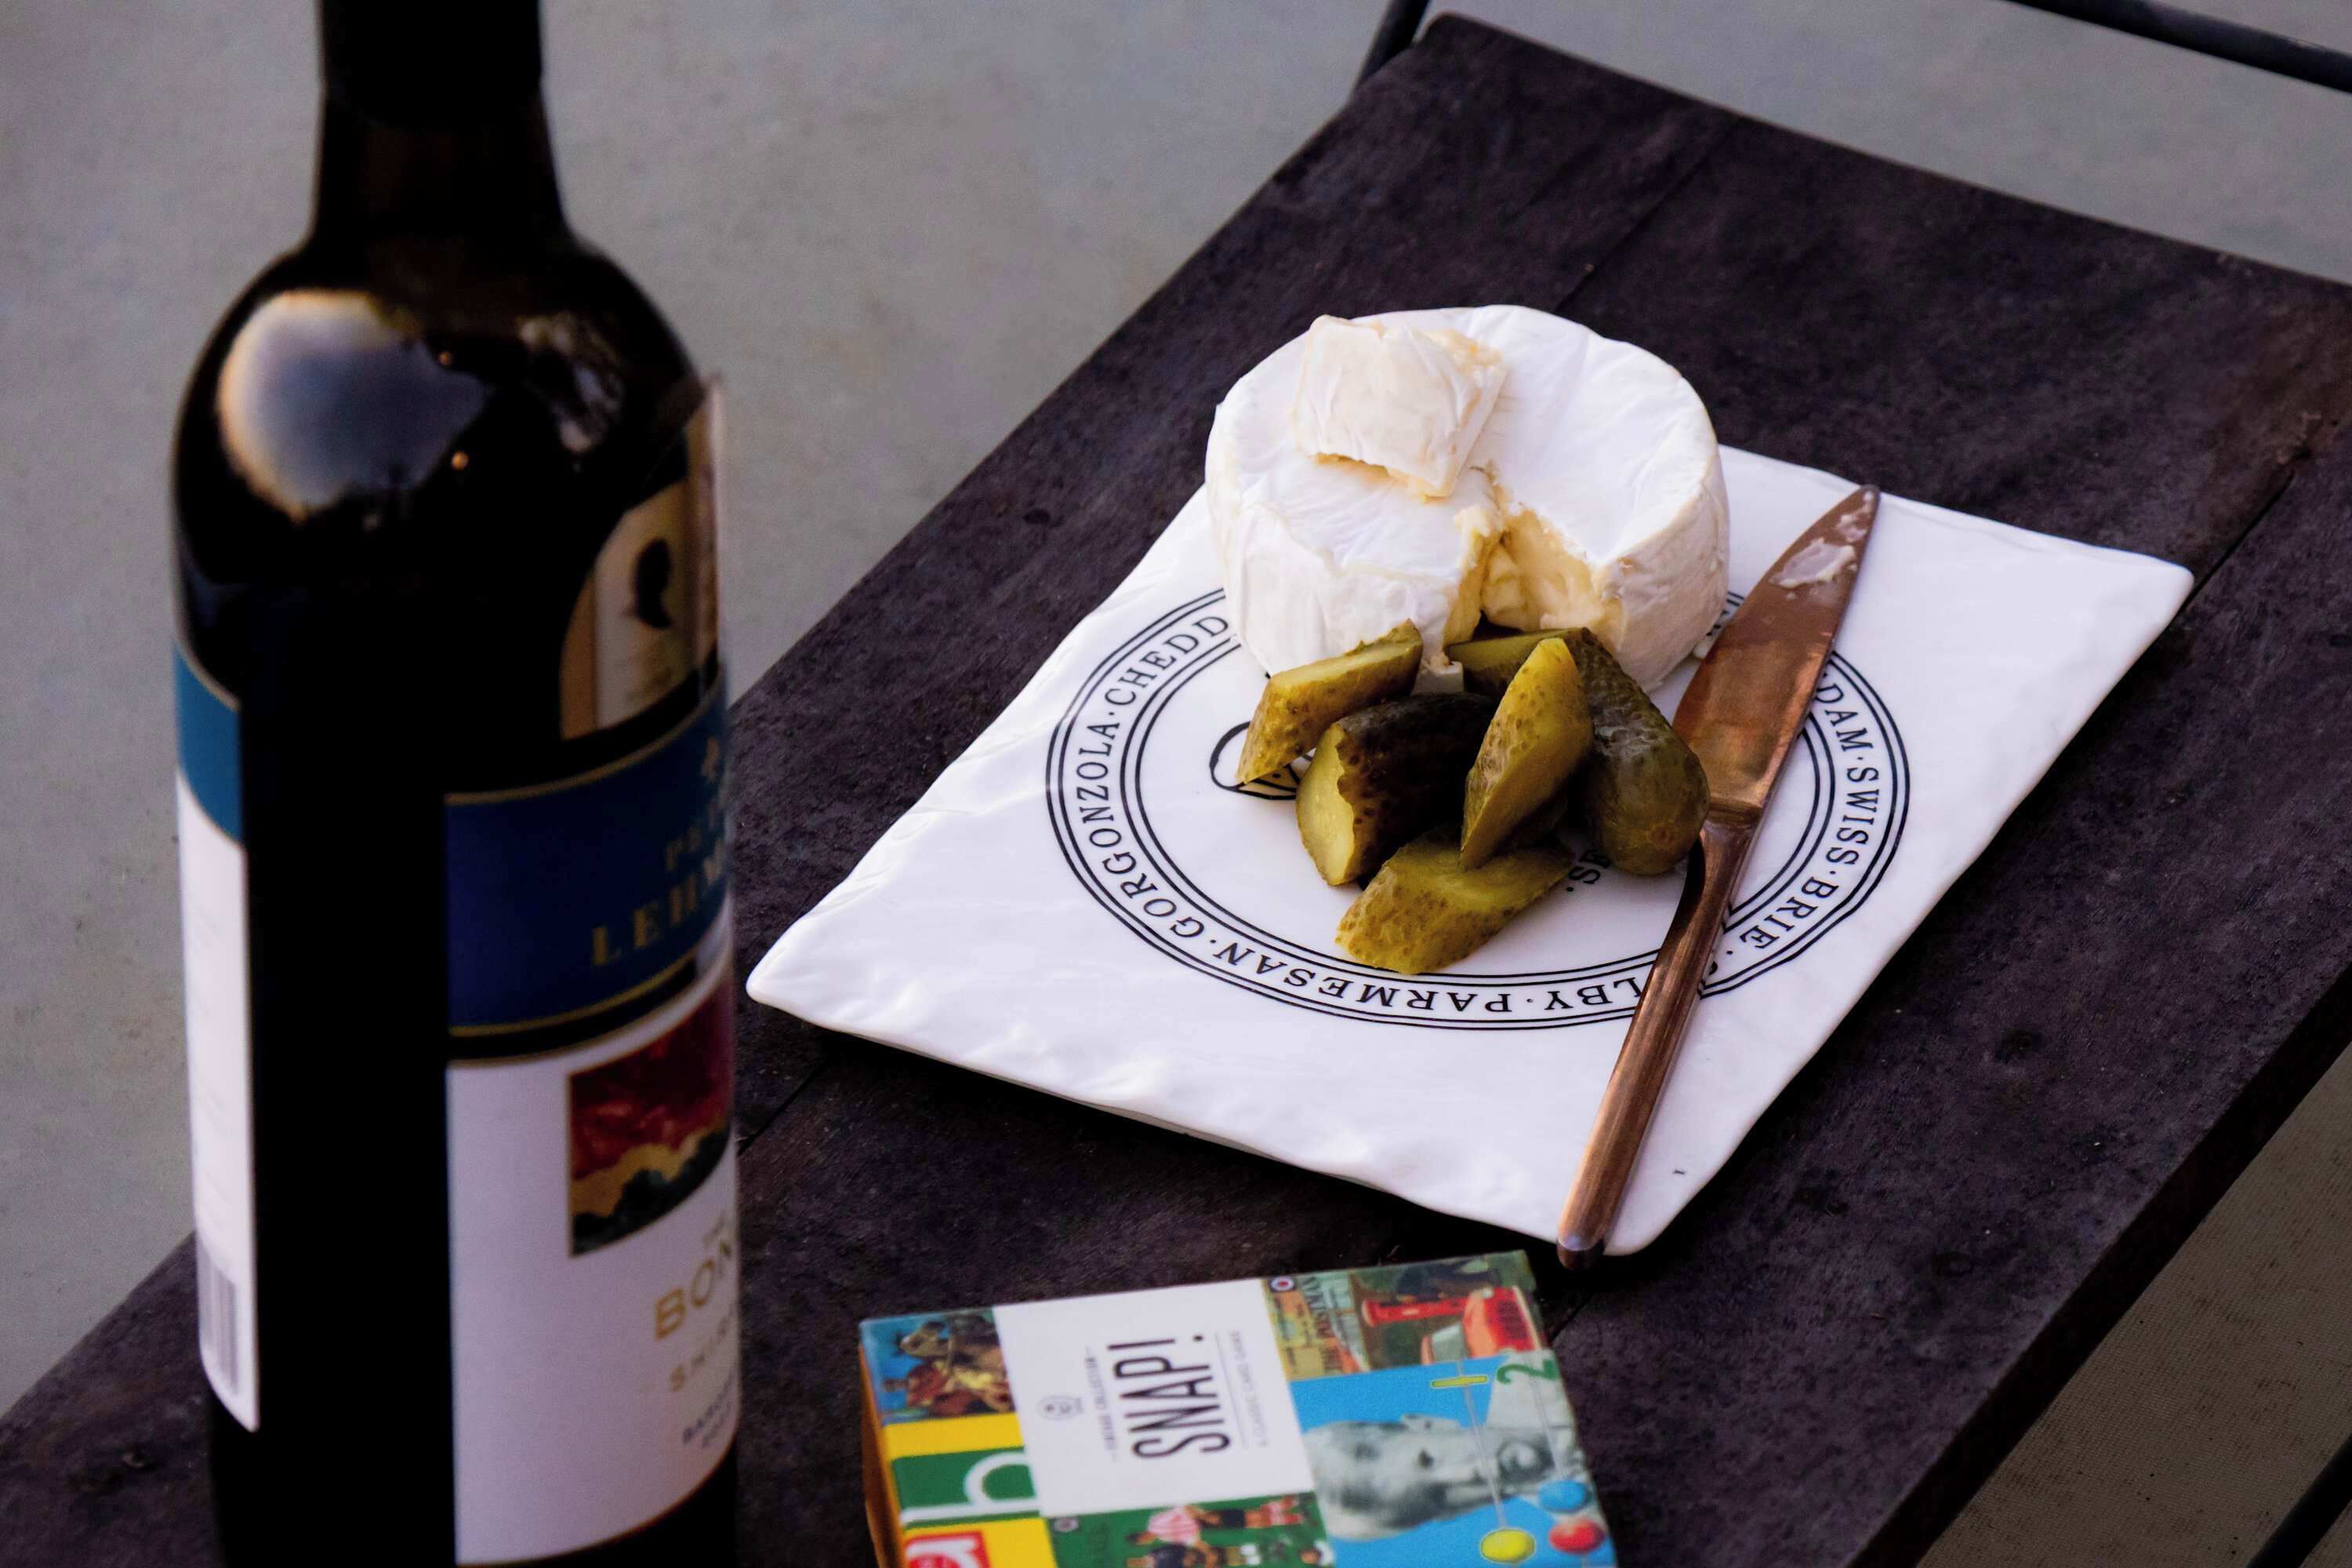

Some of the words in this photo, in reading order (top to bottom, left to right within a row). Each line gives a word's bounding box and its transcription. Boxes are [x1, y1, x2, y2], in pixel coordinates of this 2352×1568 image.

[1105, 616, 1229, 706] CHEDD
[1814, 681, 1875, 752] DAM
[1076, 722, 1205, 938] GORGONZOLA
[1825, 767, 1880, 866] SWISS
[1738, 876, 1839, 949] BRIE
[1212, 942, 1512, 1013] PARMESAN
[1544, 977, 1644, 1011] LBY
[1106, 1334, 1231, 1459] SNAP!
